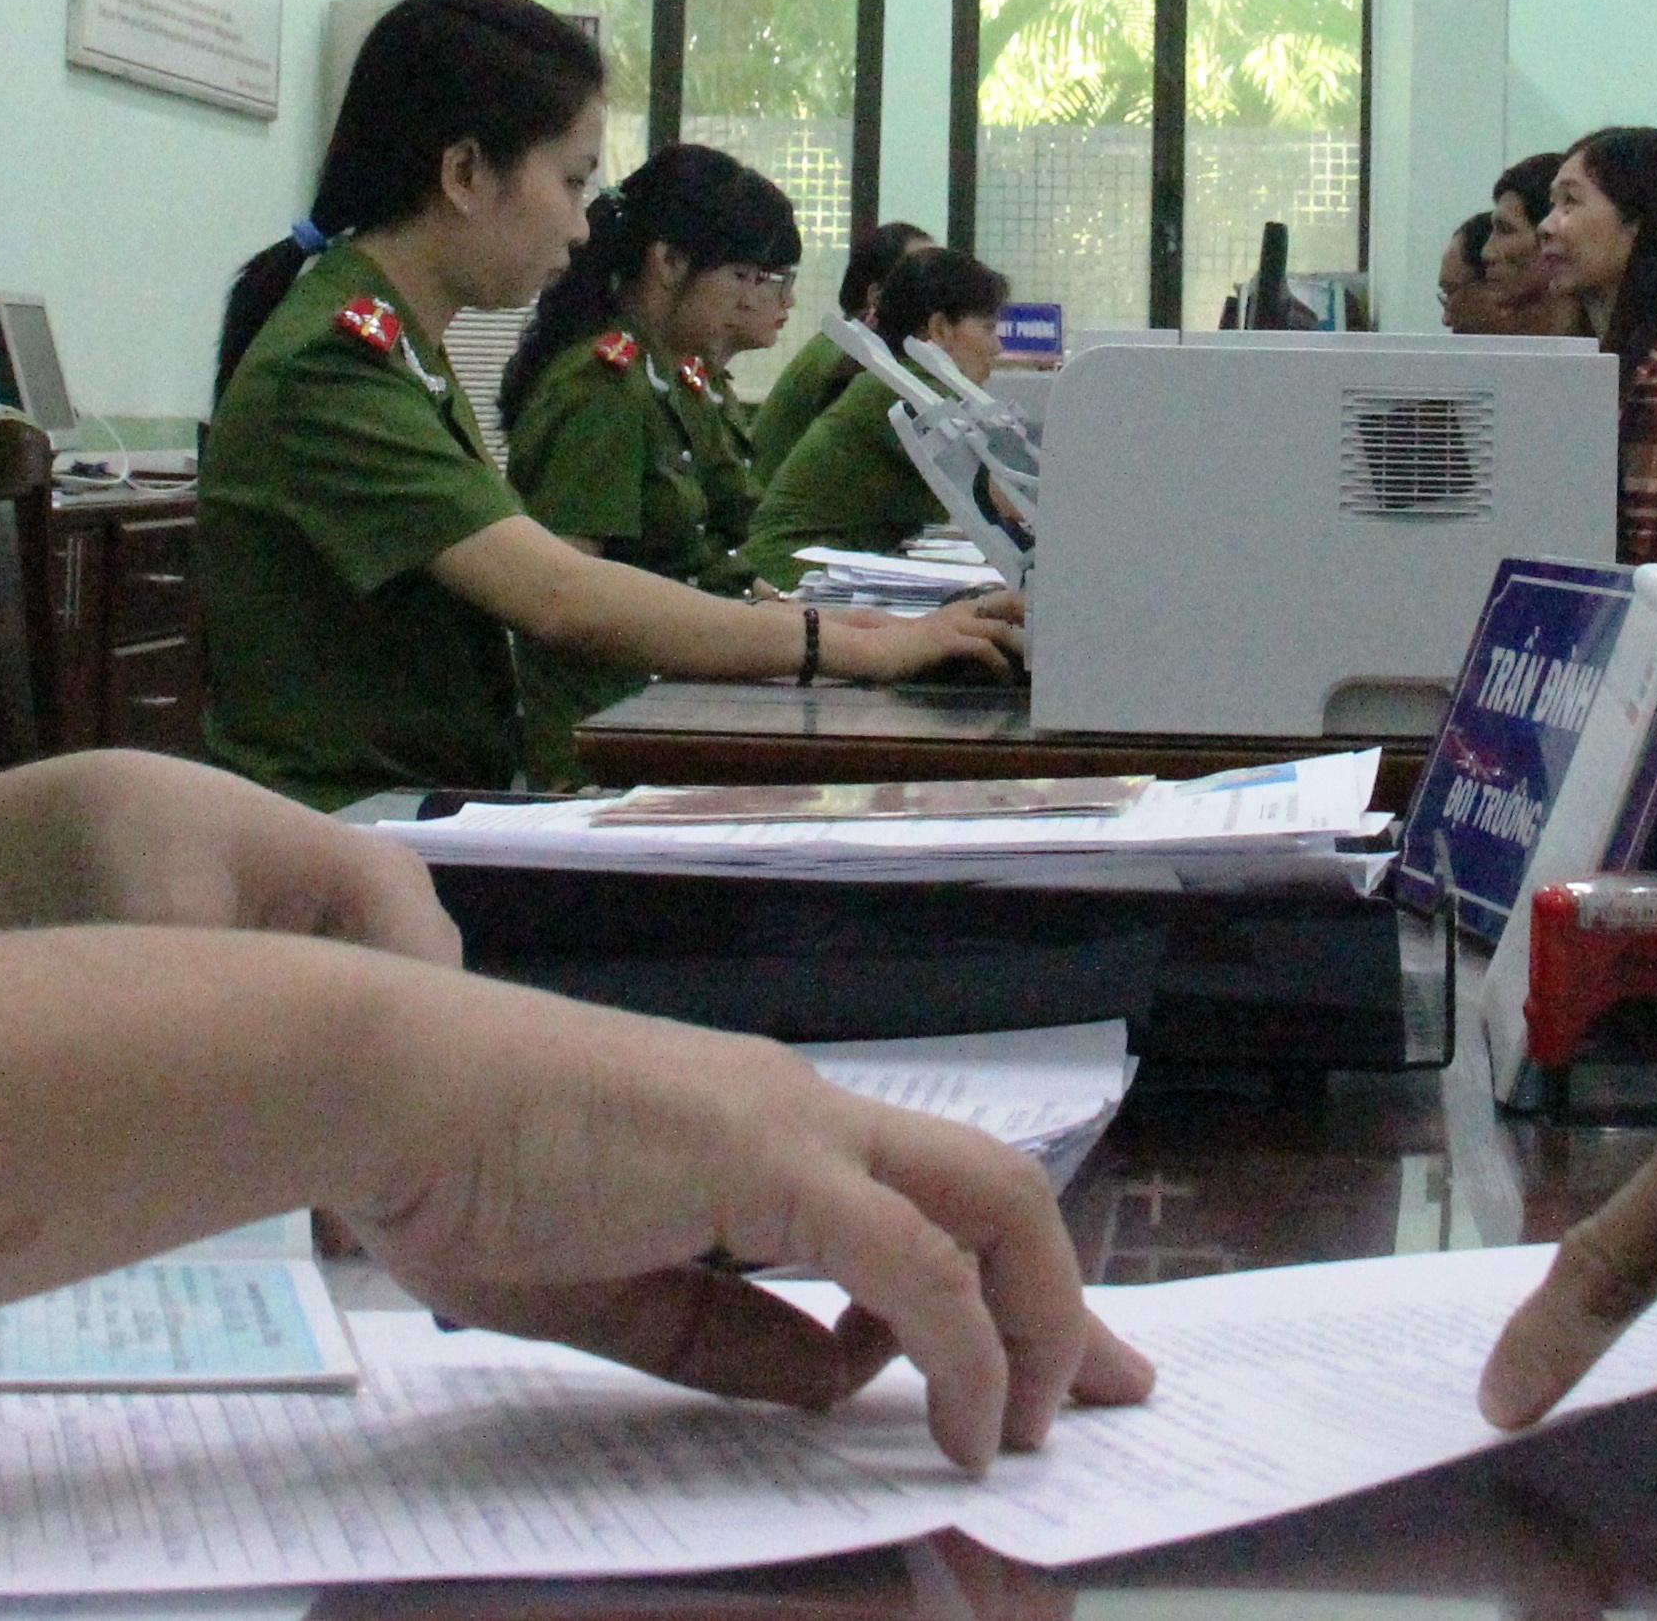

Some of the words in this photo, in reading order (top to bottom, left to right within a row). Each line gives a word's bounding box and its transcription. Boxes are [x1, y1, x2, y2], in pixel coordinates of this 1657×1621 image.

[1532, 644, 1604, 734] ĐÌNH
[1443, 769, 1480, 829] ĐỘI
[1472, 777, 1543, 848] TRƯỞNG
